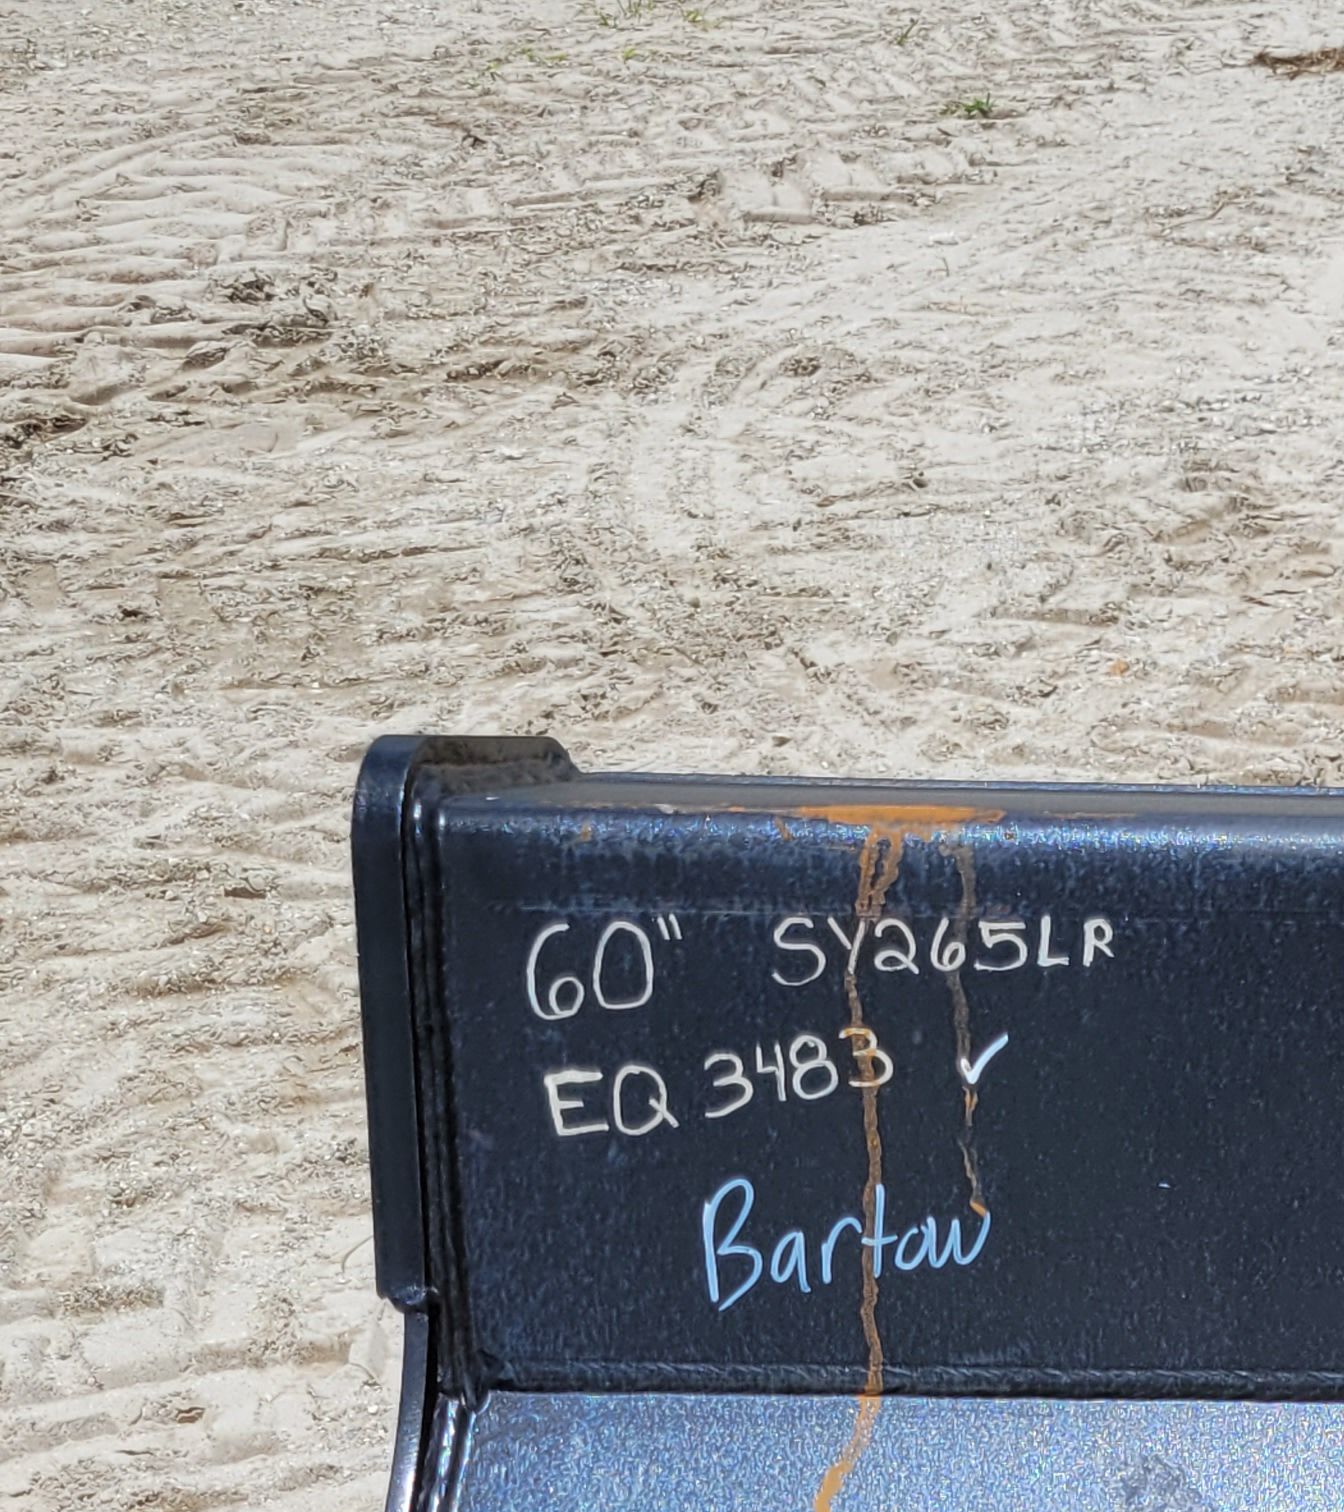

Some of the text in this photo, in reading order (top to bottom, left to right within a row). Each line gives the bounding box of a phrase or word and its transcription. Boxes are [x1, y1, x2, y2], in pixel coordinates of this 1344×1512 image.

[771, 914, 1115, 986] SY265LR
[544, 1026, 894, 1137] EQ 3483
[702, 1178, 991, 1312] Bartow
